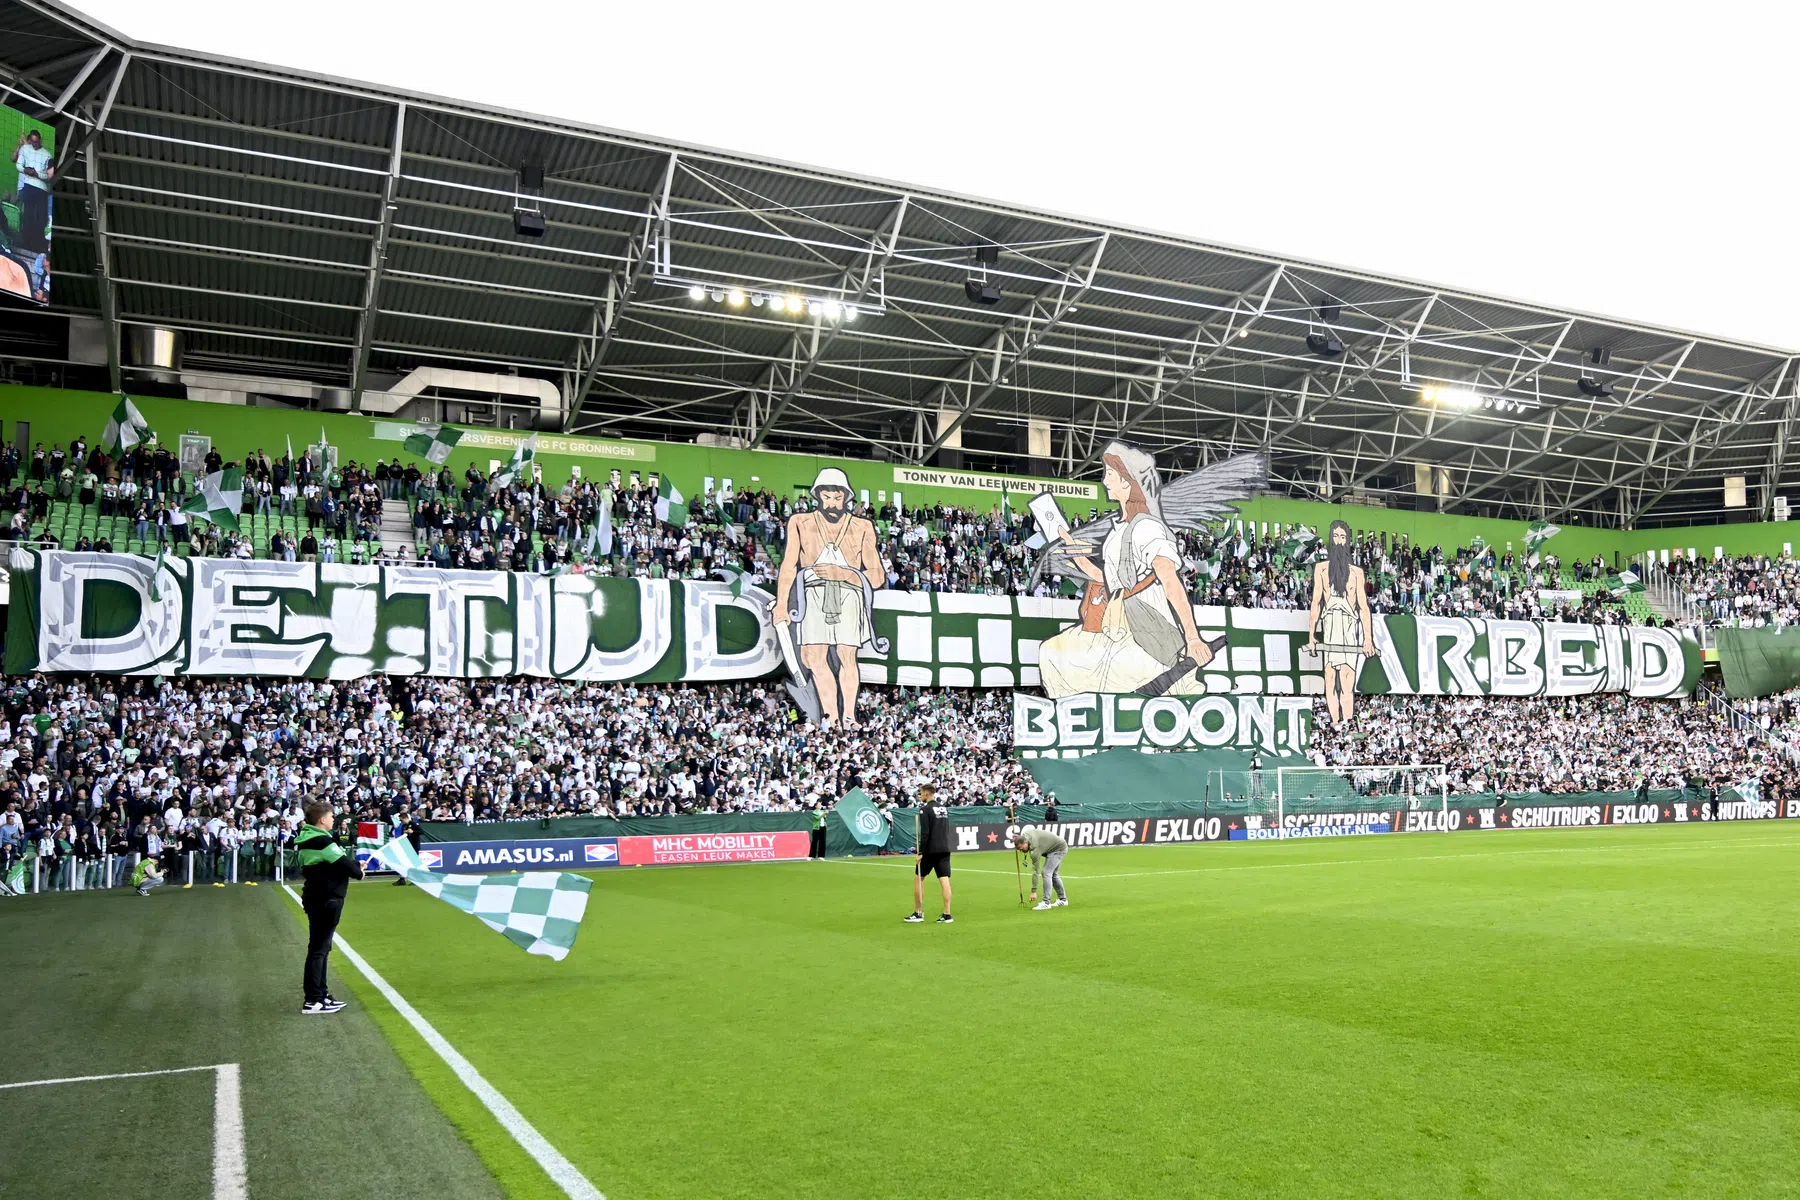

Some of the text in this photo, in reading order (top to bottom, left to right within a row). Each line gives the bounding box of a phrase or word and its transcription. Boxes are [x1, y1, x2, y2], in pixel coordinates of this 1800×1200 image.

[552, 440, 567, 450] FC
[569, 442, 635, 456] GRONINGEN
[903, 471, 1090, 496] TONNY VAN LEEUWEN TRIBUNE
[36, 549, 327, 676] DE
[1013, 692, 1313, 758] BELOONT
[1406, 809, 1461, 832] EXLOO
[1511, 804, 1659, 828] SCHUTRUPS EXLOO
[1155, 817, 1221, 842] EXLOO
[652, 835, 776, 851] MHC MOBILITY
[456, 847, 574, 866] AMASUS.nl
[654, 850, 776, 863] LEASEN LEUK MAKEN
